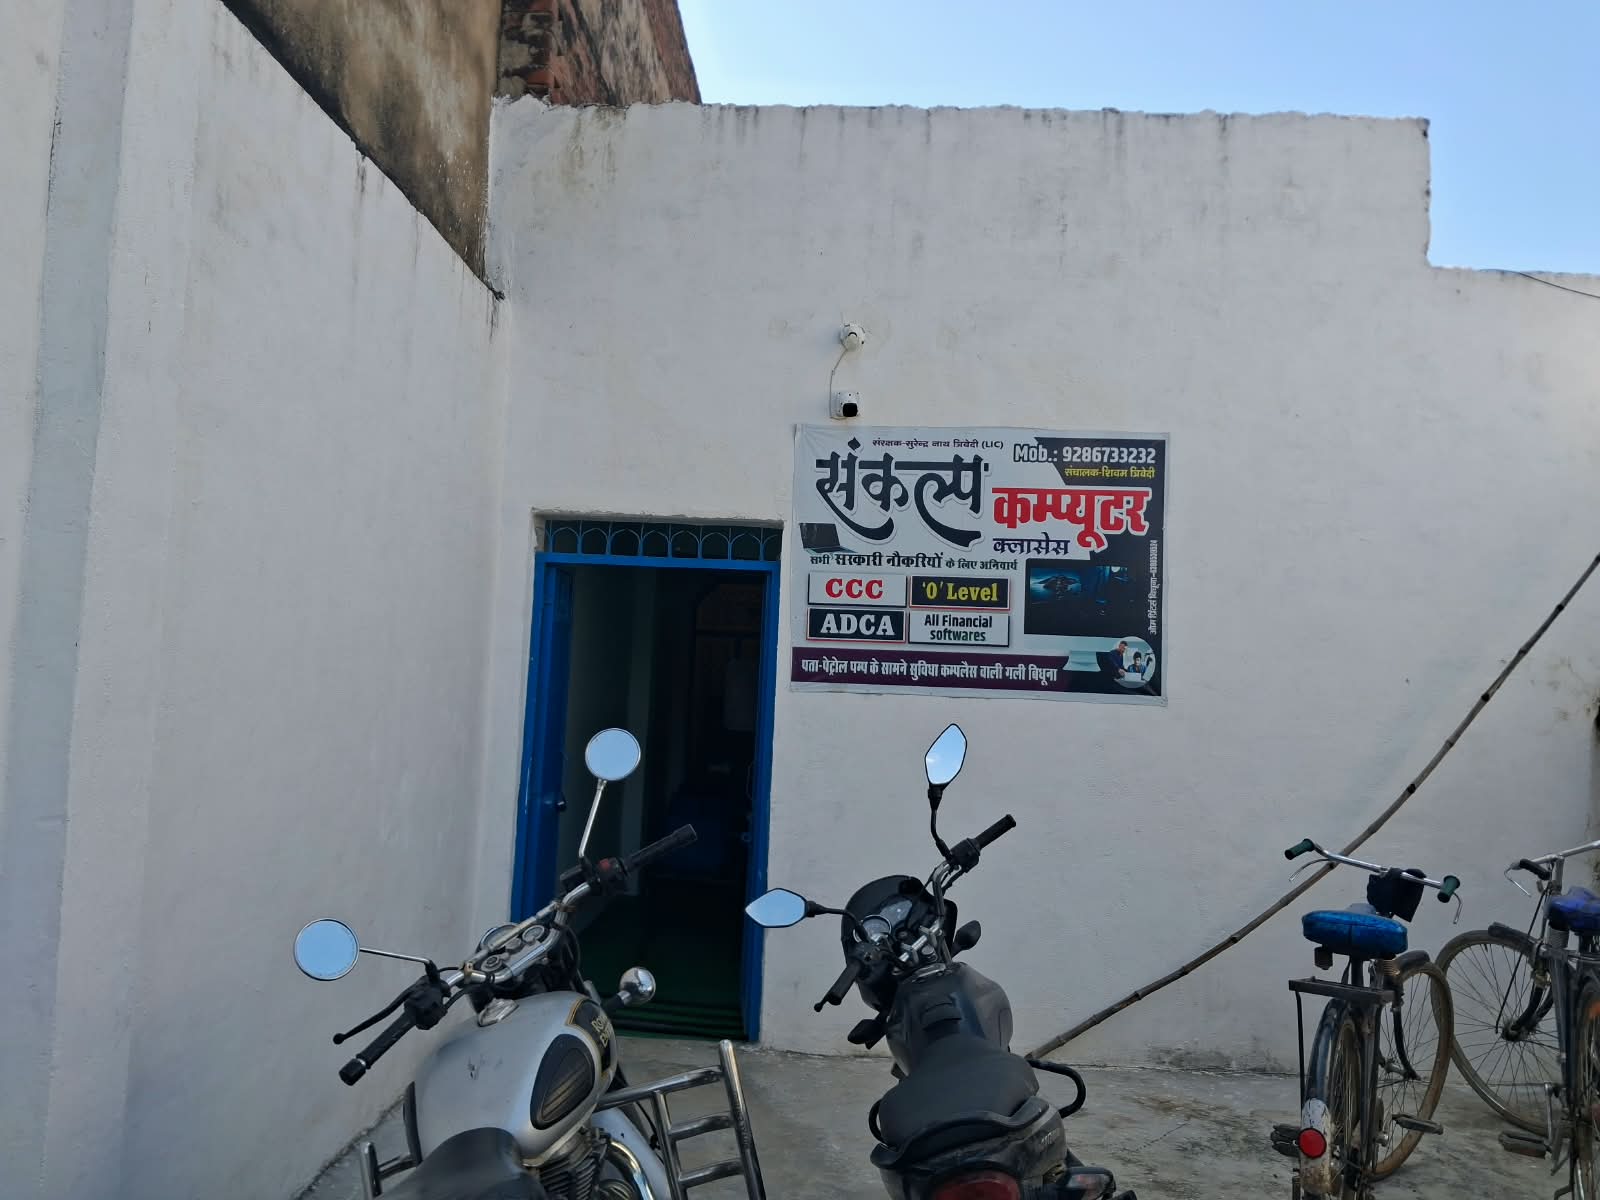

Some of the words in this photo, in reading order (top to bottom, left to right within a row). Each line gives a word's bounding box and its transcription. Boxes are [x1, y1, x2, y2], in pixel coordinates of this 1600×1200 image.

[981, 440, 1004, 449] (LIC)
[1014, 444, 1058, 463] Mob.:
[1062, 446, 1156, 464] 9286733232
[816, 437, 989, 547] संकल्प
[992, 488, 1150, 549] कम्प्यूटर
[993, 532, 1070, 555] क्लासेस
[810, 556, 830, 565] सभी
[834, 553, 883, 566] सरकारी
[886, 551, 944, 568] नौकरियों
[945, 558, 955, 568] के
[958, 558, 977, 569] लिए
[979, 559, 1018, 570] अनिवार्य
[825, 578, 884, 599] CCC
[947, 582, 998, 601] Level
[820, 613, 896, 636] ADCA
[924, 614, 939, 626] All
[942, 615, 993, 628] Financial
[930, 629, 986, 642] softwares
[801, 656, 848, 676] पता-पेट्रोल
[850, 660, 868, 674] पम्प
[870, 658, 880, 674] के
[881, 659, 908, 676] सामने
[910, 660, 939, 680] सुविधा
[980, 662, 1003, 679] वाली
[1005, 664, 1026, 680] गली
[1028, 664, 1058, 686] बिधूना
